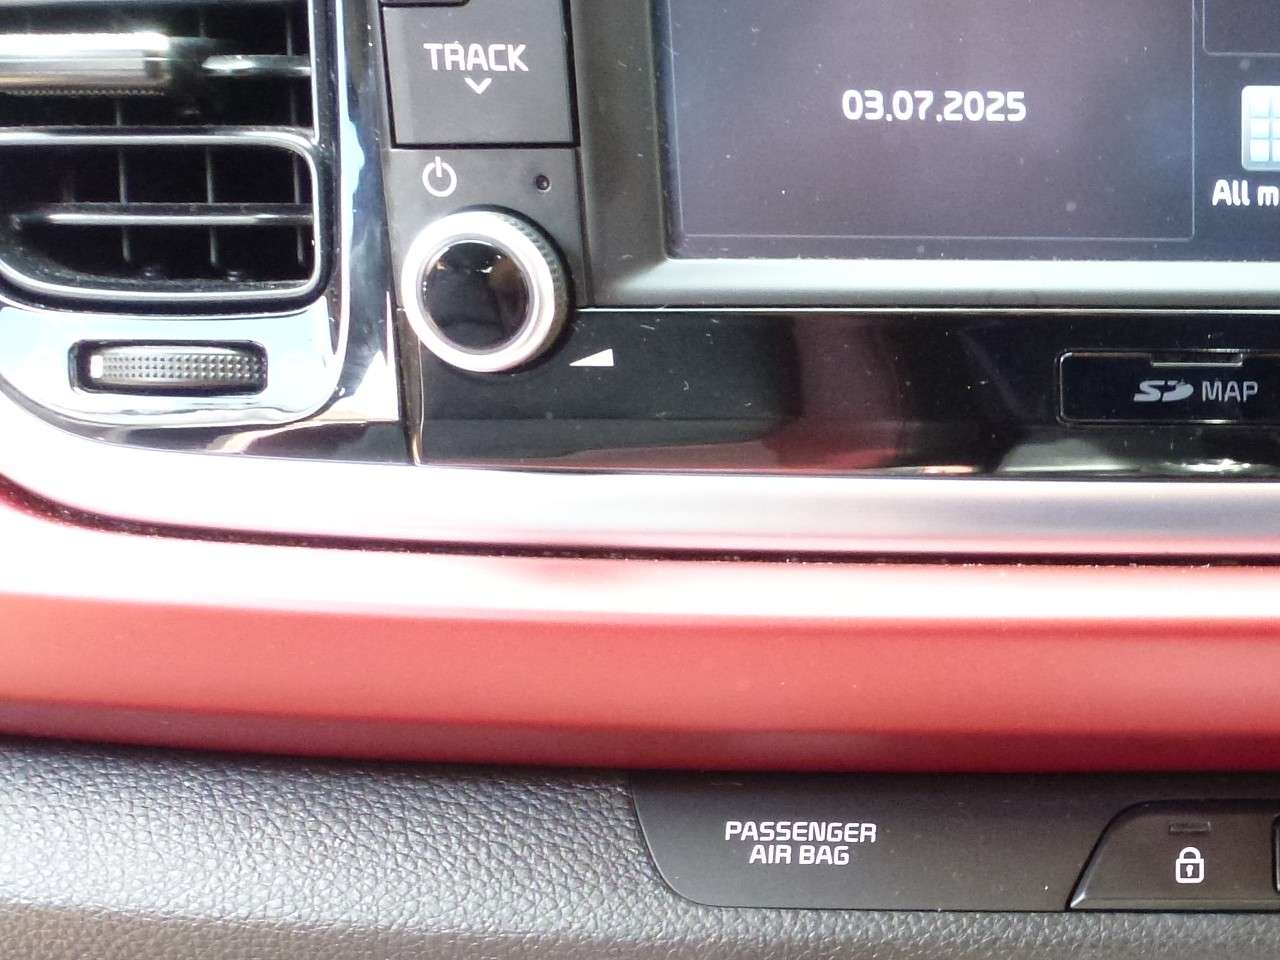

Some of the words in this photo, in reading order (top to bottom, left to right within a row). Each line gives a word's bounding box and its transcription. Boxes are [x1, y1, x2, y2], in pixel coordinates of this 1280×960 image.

[423, 42, 529, 73] TRACK
[841, 89, 1027, 123] 03.07.2025
[1211, 179, 1251, 207] All
[1201, 380, 1259, 403] MAP
[723, 820, 878, 847] PASSENGER
[747, 845, 792, 866] AIR
[798, 844, 851, 867] BAG
